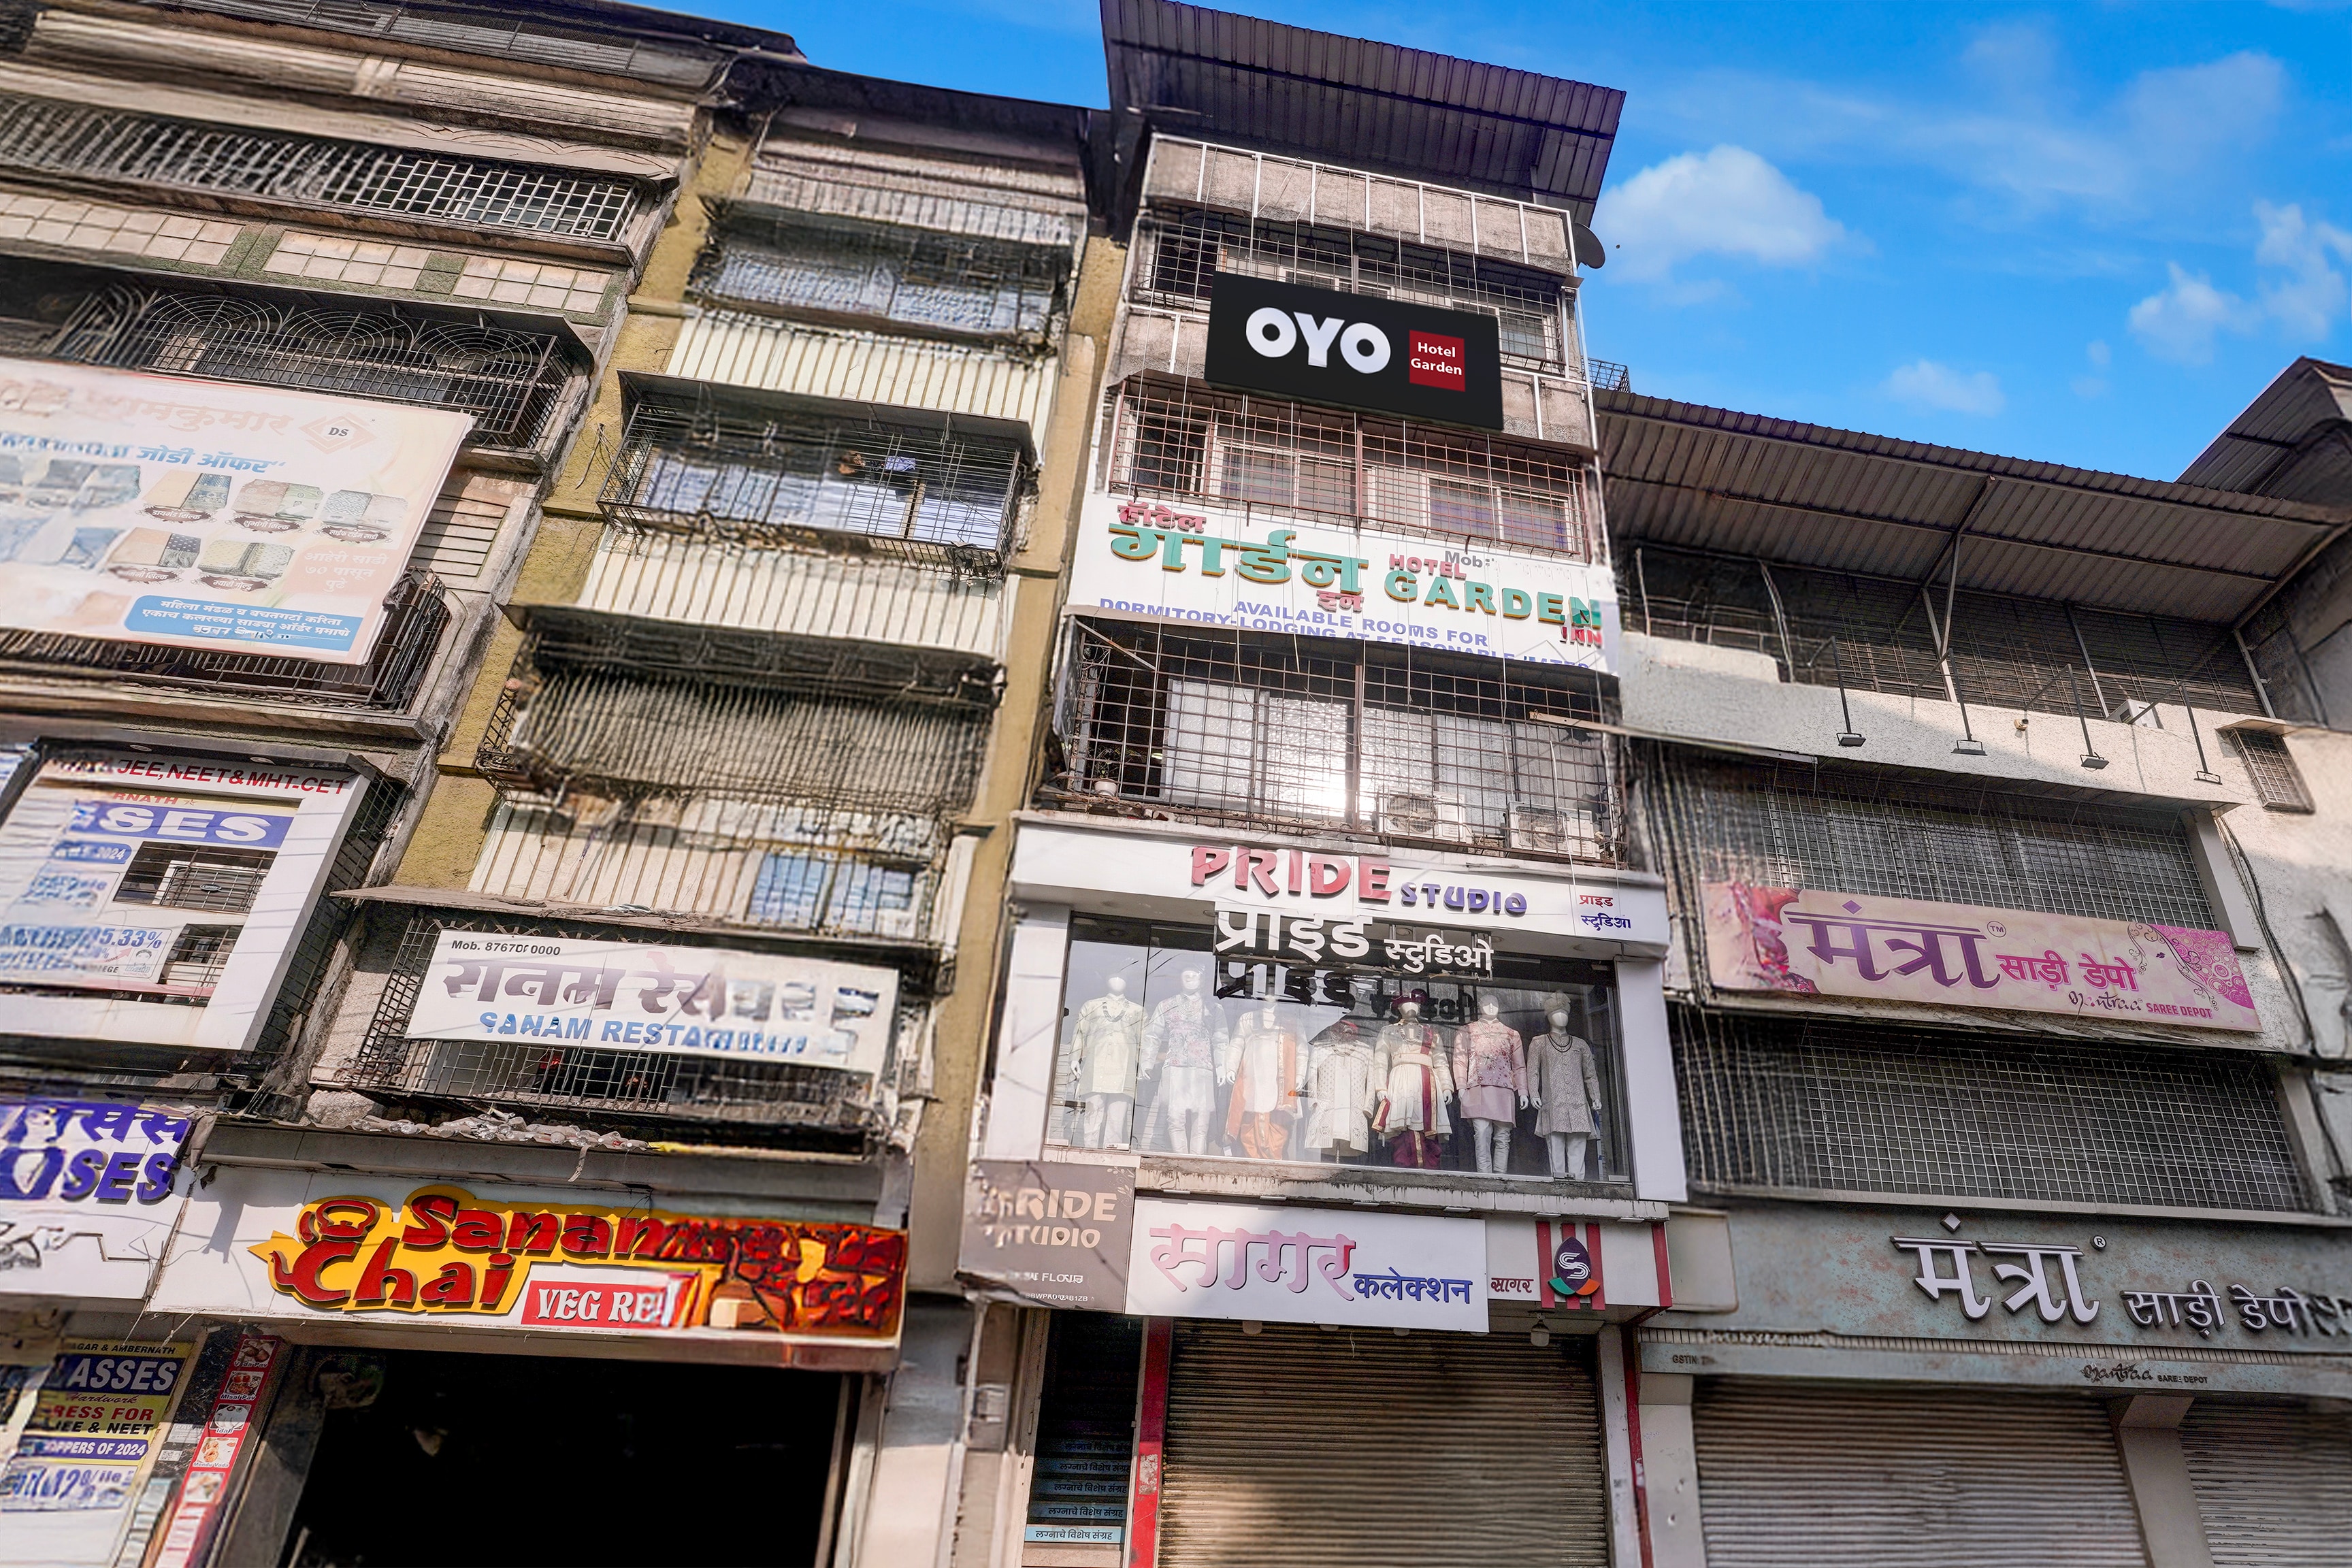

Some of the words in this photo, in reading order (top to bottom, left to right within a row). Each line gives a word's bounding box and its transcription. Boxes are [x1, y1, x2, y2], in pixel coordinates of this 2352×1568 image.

[1246, 307, 1391, 374] OYO
[1418, 342, 1456, 358] Hotel
[1411, 358, 1462, 376] Garden
[327, 427, 348, 437] DS
[1109, 523, 1369, 595] गार्डन
[1389, 553, 1467, 581] HOTEL
[1384, 570, 1603, 630] GARDEN
[1233, 600, 1353, 628] AVAILABLE
[1362, 619, 1439, 639] ROOMS
[1447, 630, 1489, 647] FOR
[1191, 846, 1392, 903] PRIDE
[1401, 881, 1528, 915] STUDIO
[1579, 895, 1614, 908] प्राइड
[451, 940, 480, 951] Mob.
[1215, 902, 1373, 963] प्राइड
[1384, 934, 1494, 973] स्टुडिओ
[1783, 900, 2001, 988] मंत्रा
[2078, 953, 2138, 990] डेपो
[2146, 1002, 2179, 1015] SAREE
[2180, 1006, 2212, 1019] DEPOT
[272, 1237, 514, 1307] Chai
[1149, 1223, 1356, 1301] सागर
[1353, 1267, 1473, 1305] कलेक्शन
[1889, 1212, 2101, 1324] मंत्रा
[1490, 1277, 1534, 1293] सागर
[538, 1288, 602, 1321] VEG
[112, 1344, 176, 1354] AMBERNATH
[2157, 1375, 2182, 1383] SAREE
[2183, 1375, 2208, 1384] DEPOT
[111, 1407, 154, 1421] FOR
[87, 1422, 101, 1433] &
[106, 1422, 154, 1435] NEET
[97, 1442, 115, 1455] OF
[114, 1442, 147, 1456] 2024
[1054, 1483, 1083, 1492] लग्नाचे
[1084, 1483, 1106, 1492] विशेष
[1048, 1507, 1078, 1516] लग्नाचे
[1079, 1507, 1102, 1516] विशेष
[1103, 1507, 1124, 1518] संग्रह
[1035, 1529, 1066, 1539] लग्नाचे
[1068, 1529, 1090, 1540] विशेष
[1092, 1529, 1113, 1540] संग्रह
